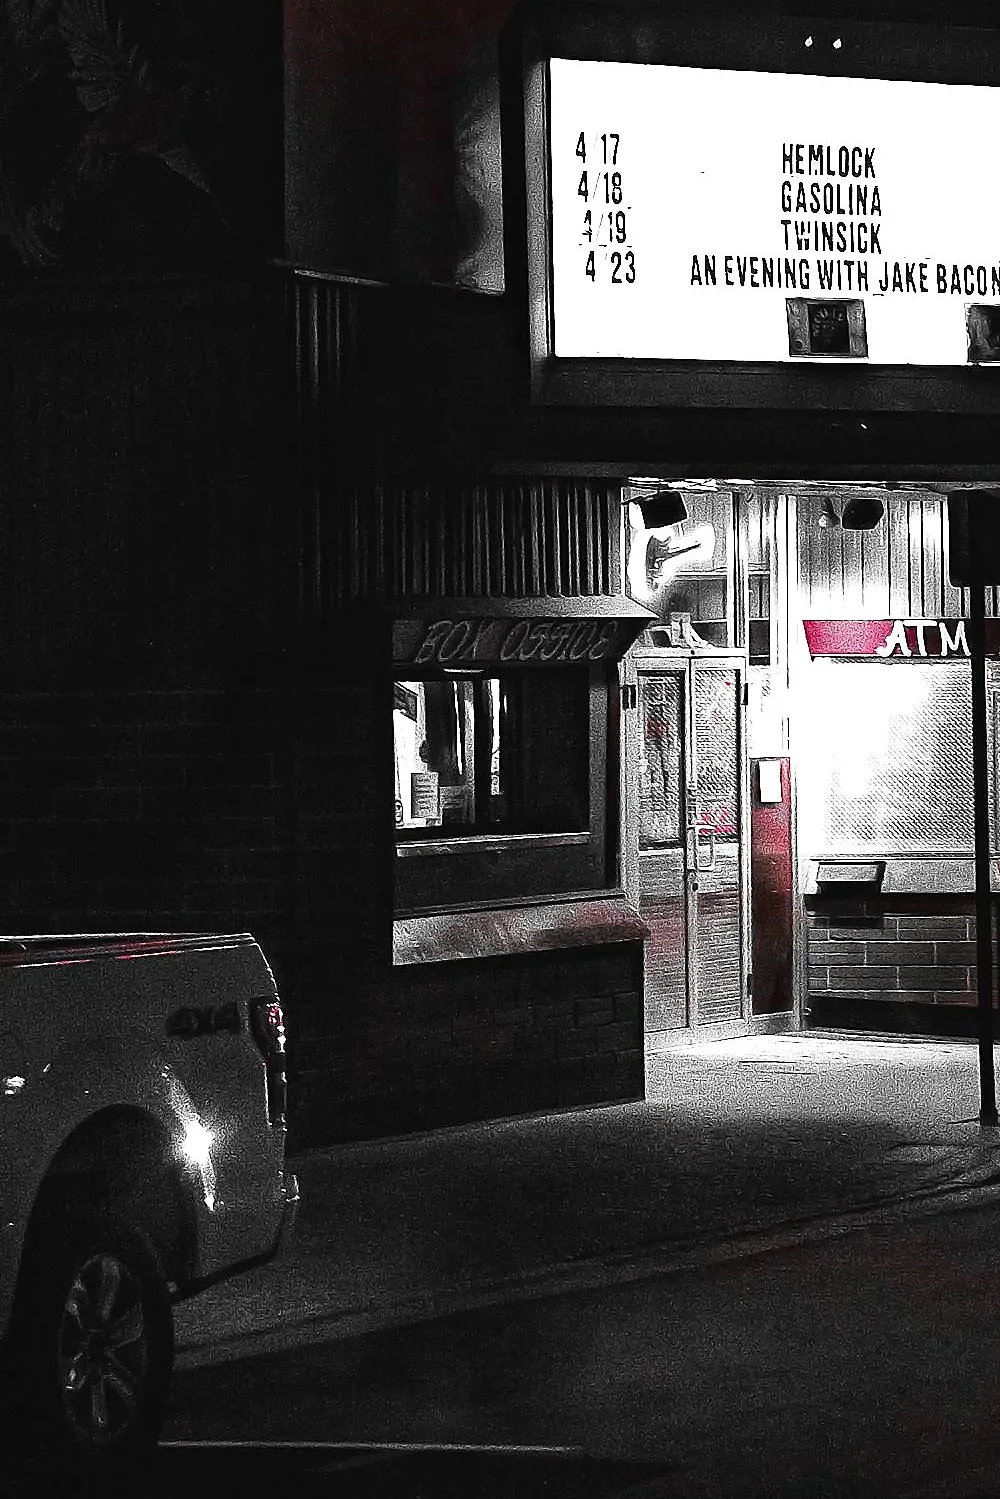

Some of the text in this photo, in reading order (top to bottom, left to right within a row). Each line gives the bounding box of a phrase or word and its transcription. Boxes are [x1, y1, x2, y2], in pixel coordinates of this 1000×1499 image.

[781, 142, 876, 179] HEMLOCK
[780, 180, 882, 217] GASOLINA
[780, 219, 882, 255] TWINSICK
[690, 254, 716, 286] AN
[724, 255, 810, 290] EVENING
[816, 259, 869, 292] WITH
[878, 261, 929, 294] JAKE
[414, 618, 618, 664] BOX OFFICE
[875, 619, 973, 658] ATM
